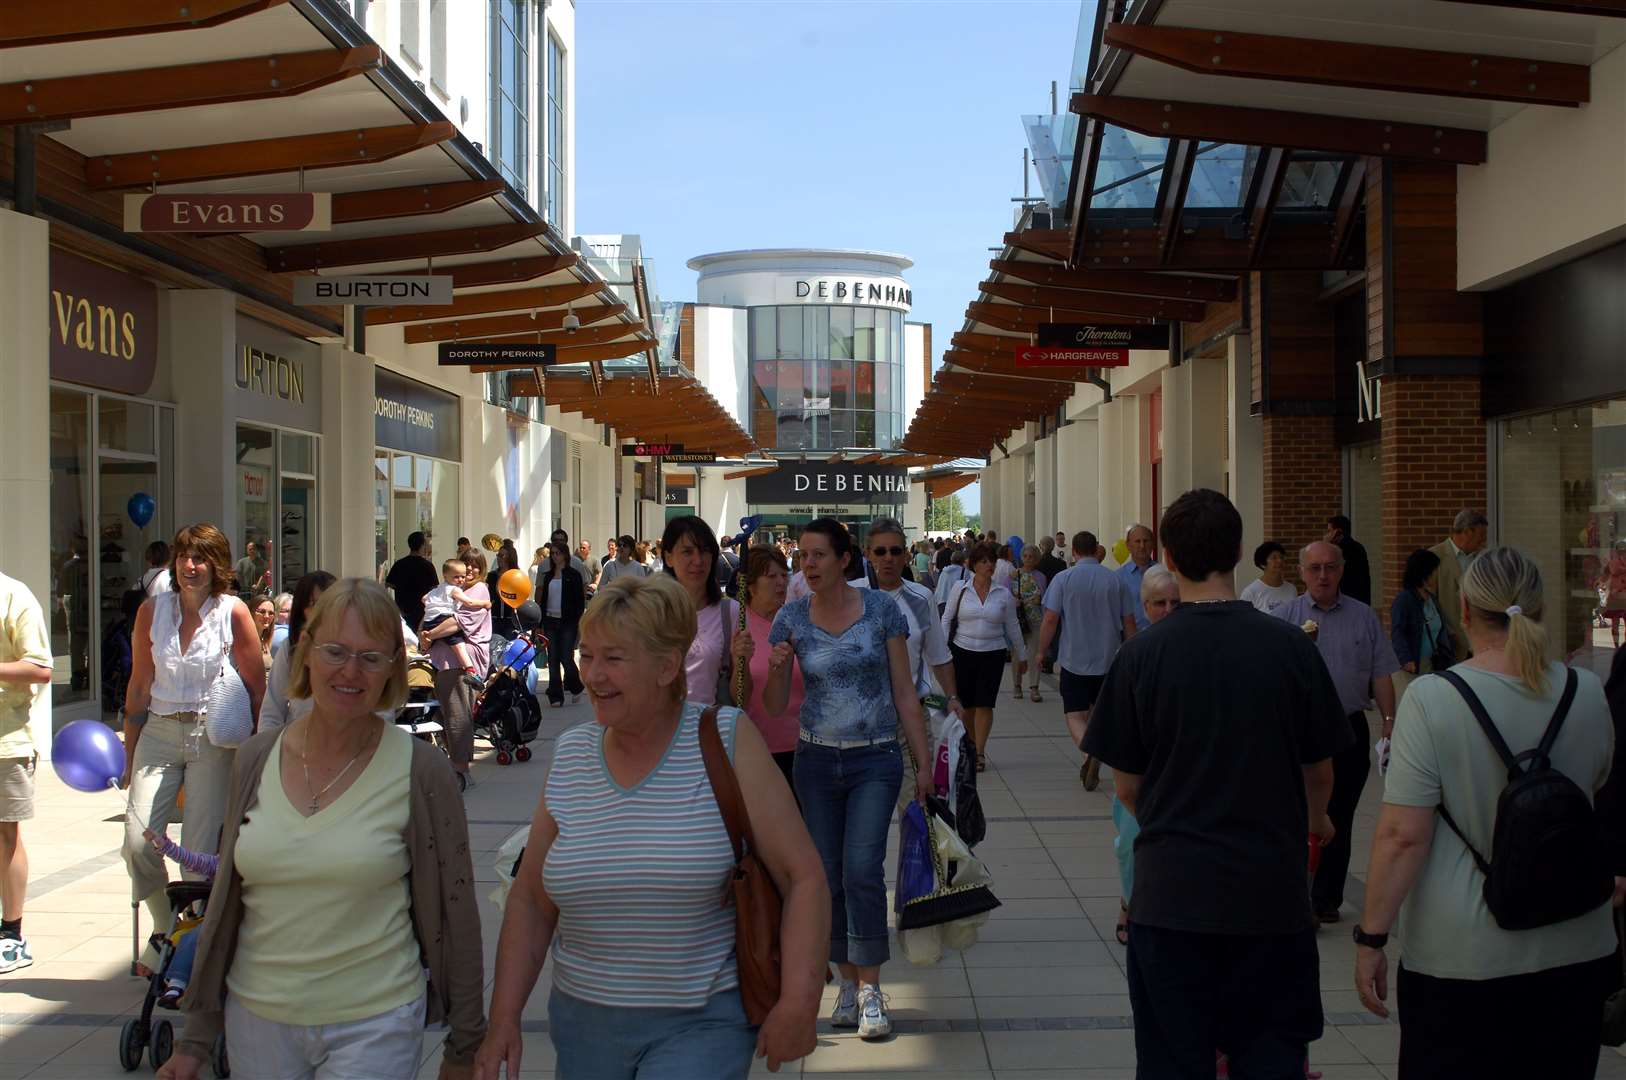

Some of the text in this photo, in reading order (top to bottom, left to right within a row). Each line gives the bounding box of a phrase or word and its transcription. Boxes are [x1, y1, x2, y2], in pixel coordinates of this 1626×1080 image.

[170, 201, 284, 224] Evans
[316, 282, 429, 297] BURTON
[52, 290, 135, 360] vans
[1075, 326, 1132, 342] Thorntons
[501, 350, 545, 358] PERKINS
[1050, 351, 1119, 360] HARGREAVES
[407, 406, 434, 430] PERKINS
